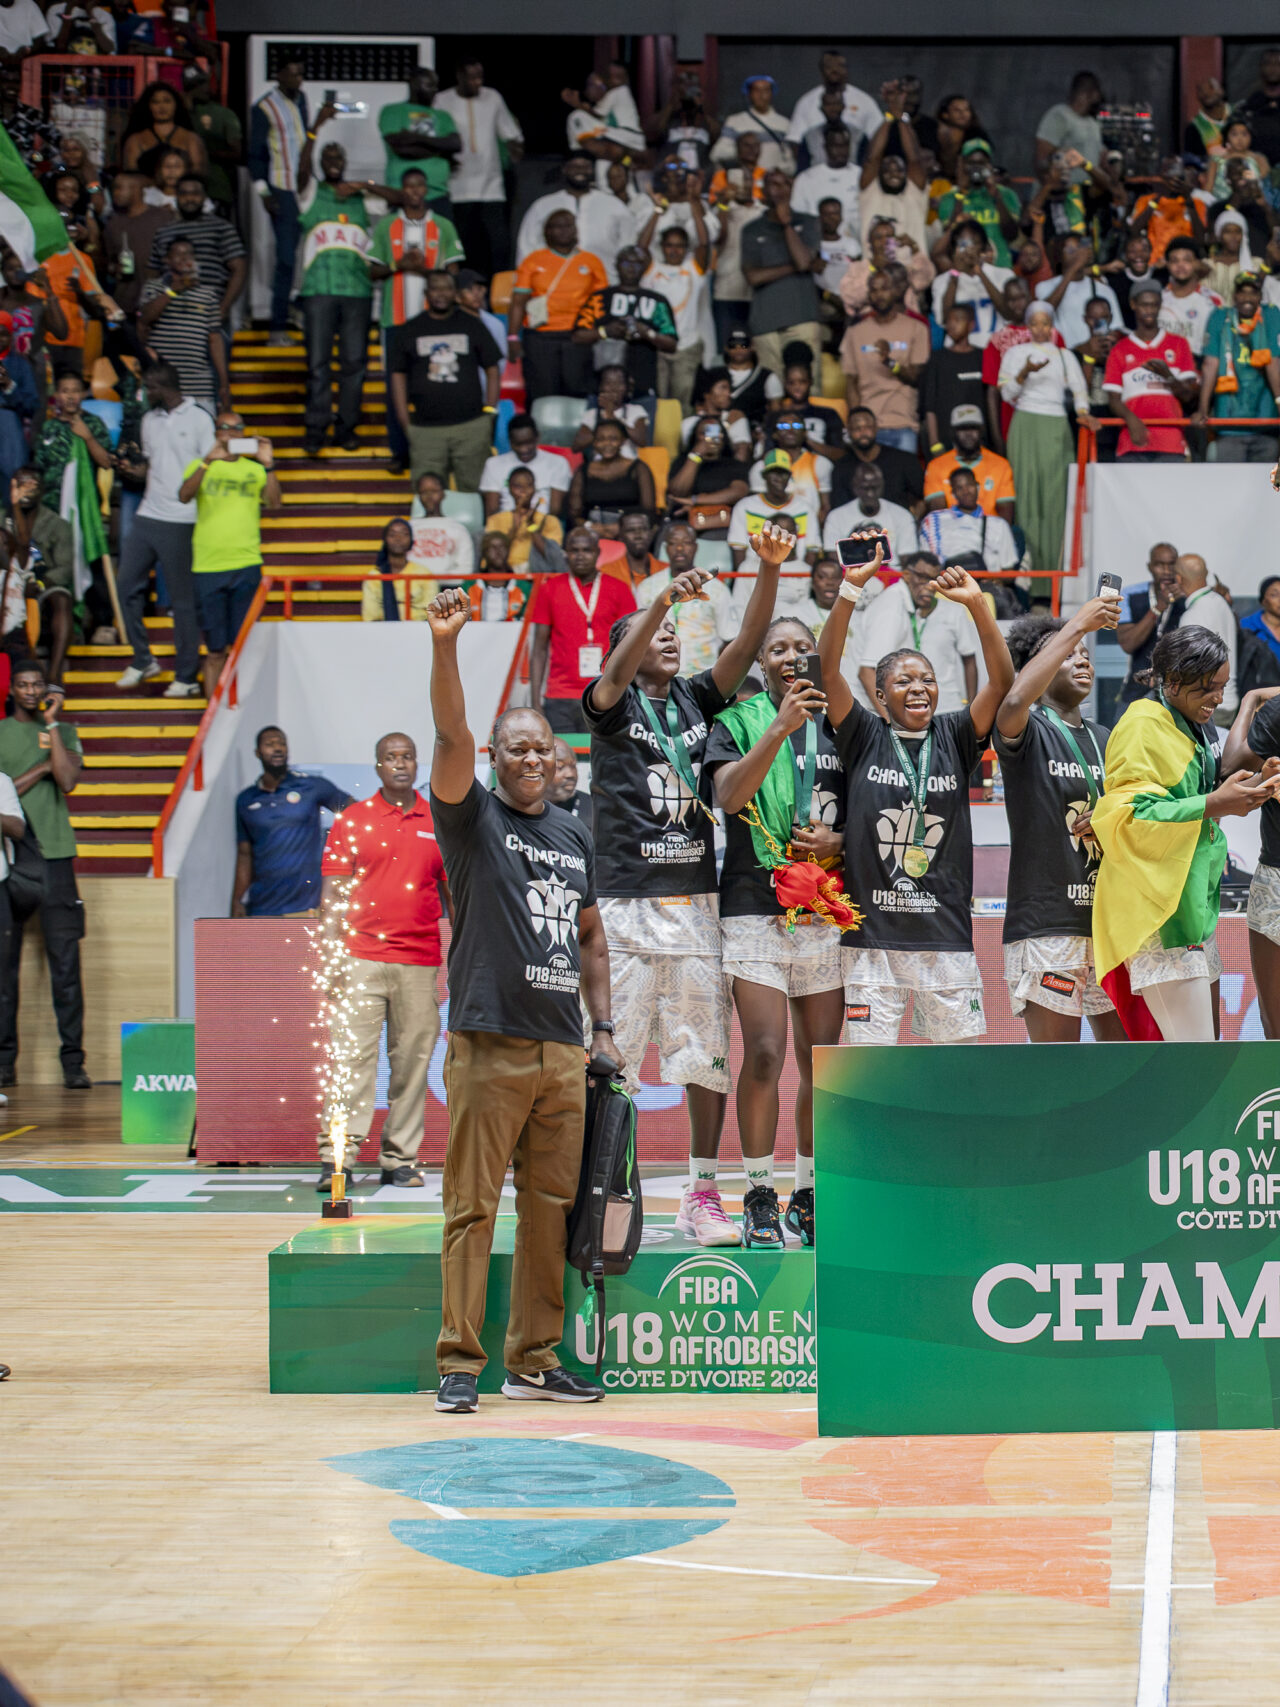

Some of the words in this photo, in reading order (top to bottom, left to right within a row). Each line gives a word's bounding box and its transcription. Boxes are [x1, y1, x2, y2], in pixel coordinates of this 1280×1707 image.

[867, 765, 958, 793] CHAMONS
[641, 842, 666, 857] U18
[897, 882, 914, 891] FIBA
[1067, 884, 1090, 900] U18
[872, 889, 897, 906] U18
[525, 964, 550, 983] U18
[132, 1074, 197, 1092] AKWA
[1148, 1148, 1241, 1206] U18
[1177, 1207, 1244, 1230] CÔTE
[679, 1275, 738, 1305] FIBA
[575, 1311, 663, 1365] U18
[669, 1310, 812, 1333] WOMEN
[669, 1335, 817, 1365] AFROBASK
[602, 1367, 666, 1388] CÔTE
[670, 1369, 766, 1388] D'IVOIRE
[771, 1369, 818, 1388] 2026
